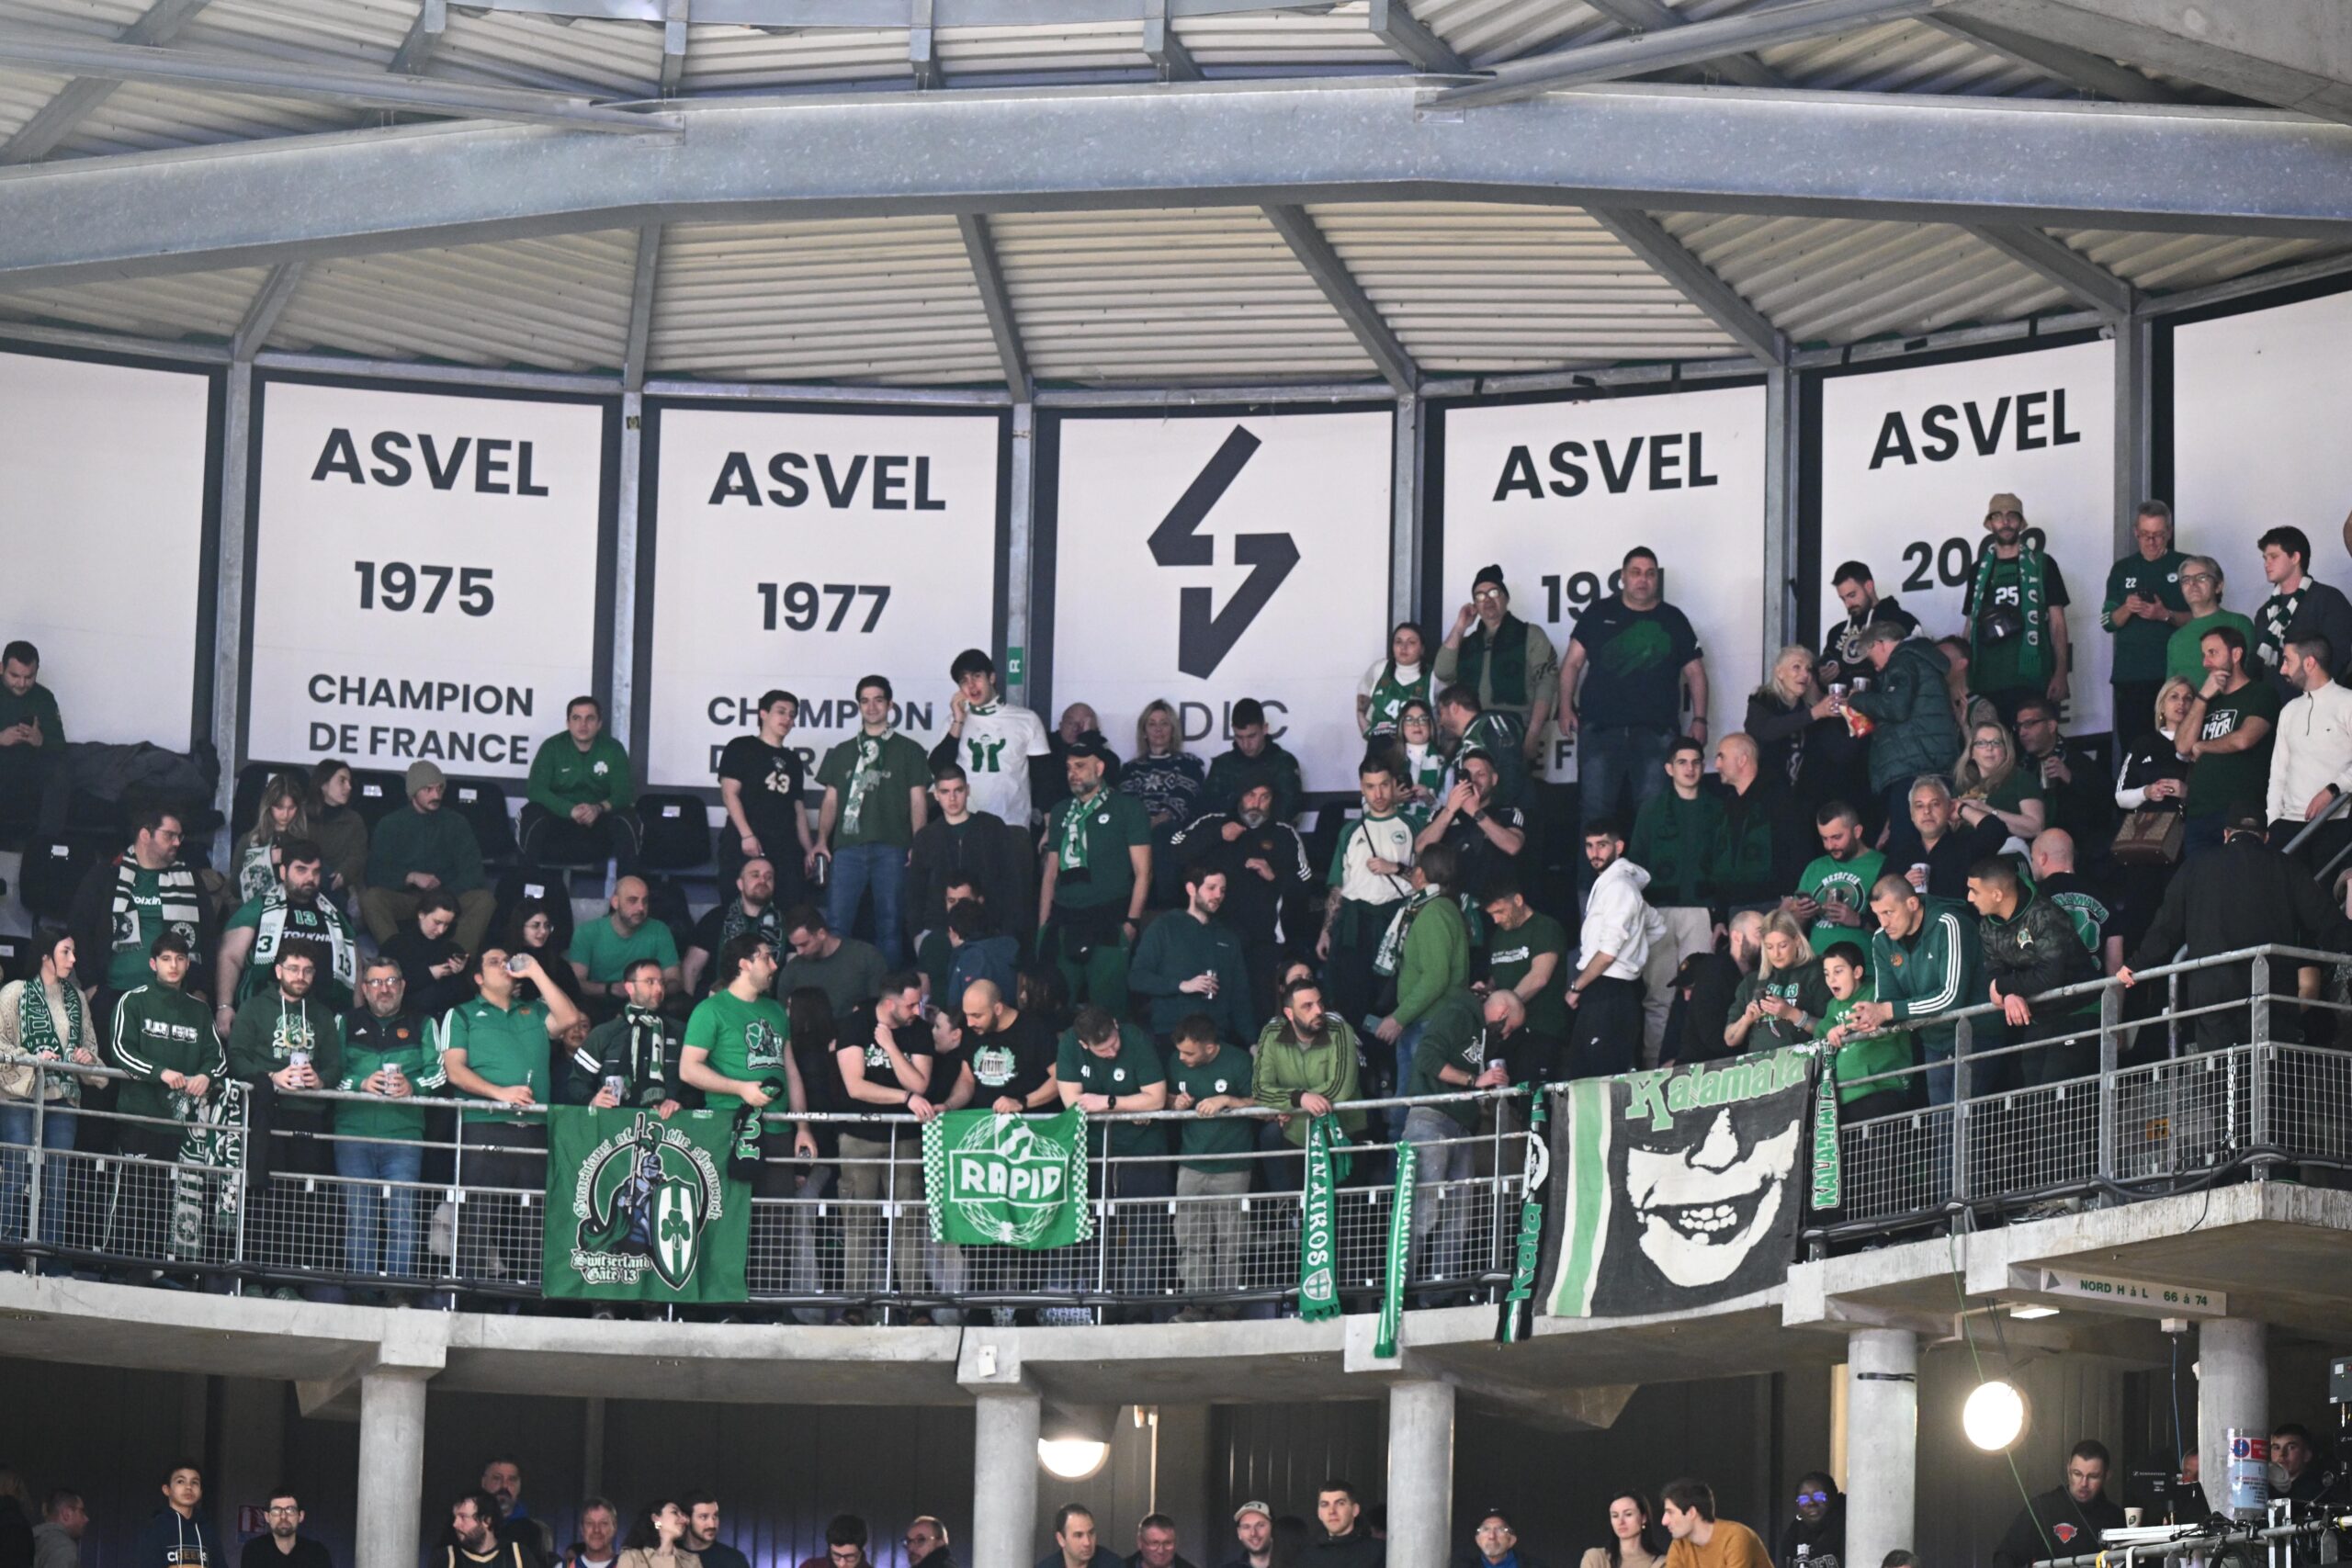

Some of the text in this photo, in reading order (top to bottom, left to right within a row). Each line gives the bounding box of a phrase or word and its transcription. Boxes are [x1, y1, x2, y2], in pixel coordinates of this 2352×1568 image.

[1869, 389, 2081, 470] ASVEL
[311, 427, 549, 497] ASVEL
[707, 451, 946, 511] ASVEL
[1492, 431, 1719, 502] ASVEL
[355, 560, 494, 617] 1975
[757, 581, 891, 634] 1977
[1995, 585, 2019, 606] 25
[309, 672, 535, 718] CHAMPION
[707, 695, 933, 731] CHMPON
[310, 722, 531, 766] DE FRANCE
[764, 771, 790, 795] 43
[293, 909, 318, 926] 13
[338, 953, 352, 976] 13
[1624, 1049, 1807, 1133] Kalamata
[960, 1158, 1062, 1200] RAPID
[571, 1251, 652, 1270] Switzerland
[621, 1268, 639, 1283] 13
[2080, 1280, 2112, 1293] NORD
[2117, 1284, 2125, 1295] H
[2142, 1288, 2149, 1299] L
[2163, 1291, 2178, 1303] 66
[2195, 1295, 2208, 1306] 74
